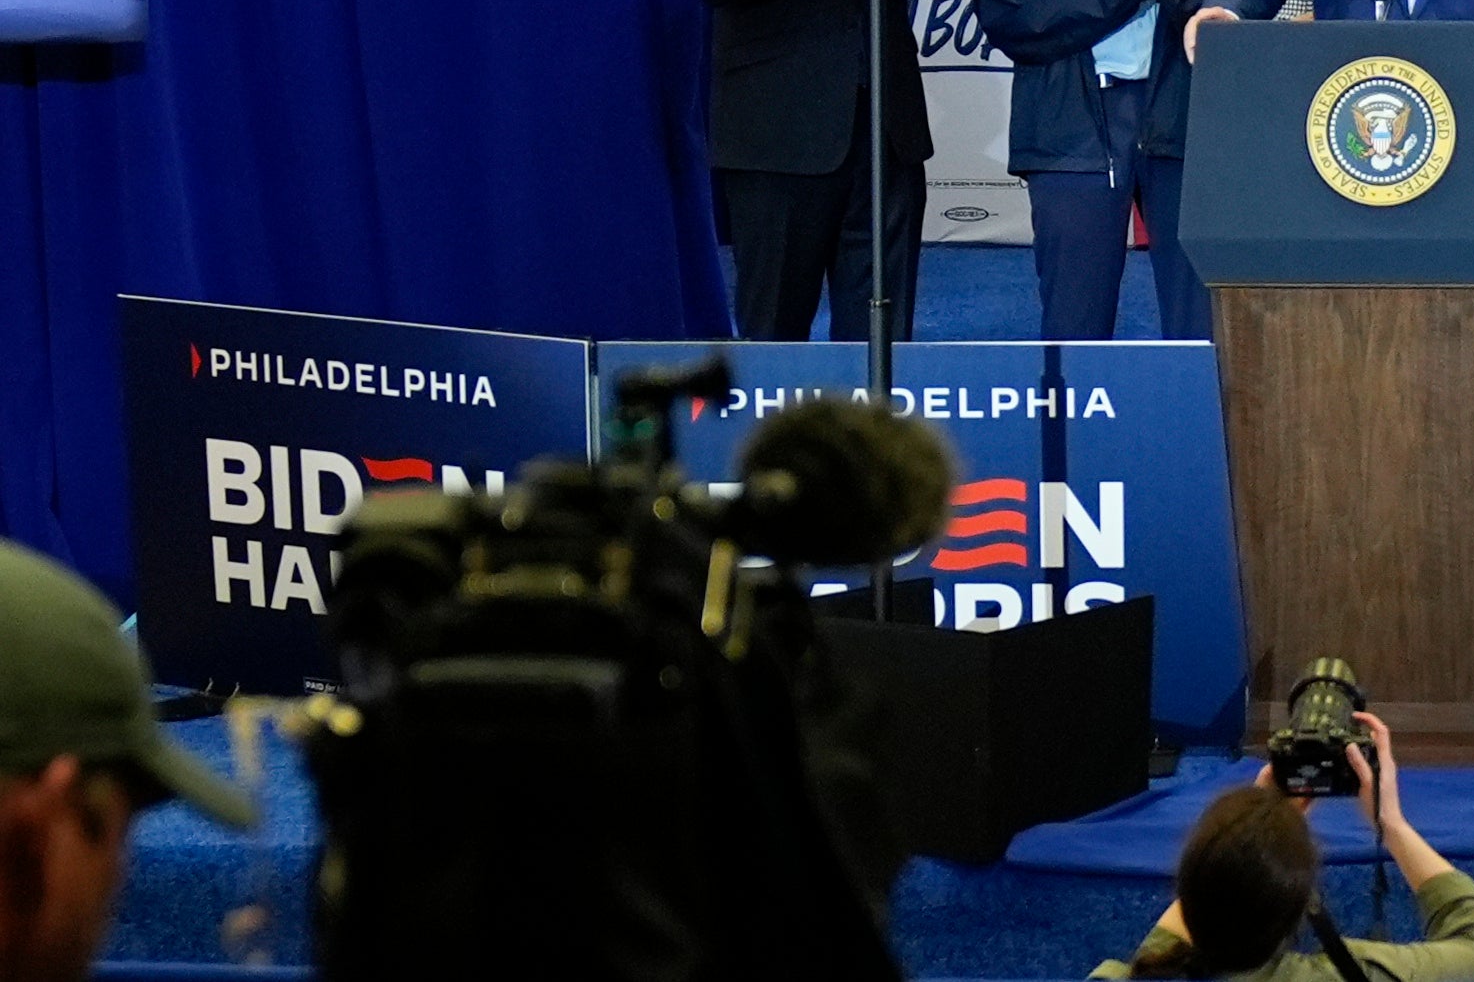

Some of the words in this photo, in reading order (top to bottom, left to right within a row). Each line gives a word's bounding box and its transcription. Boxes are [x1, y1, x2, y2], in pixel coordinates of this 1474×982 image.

[1313, 62, 1378, 127] PRESIDENT
[1419, 80, 1450, 140] UNITED
[1331, 166, 1368, 198] SEAL
[1394, 153, 1444, 198] STATES
[210, 347, 497, 408] PHILADELPHIA
